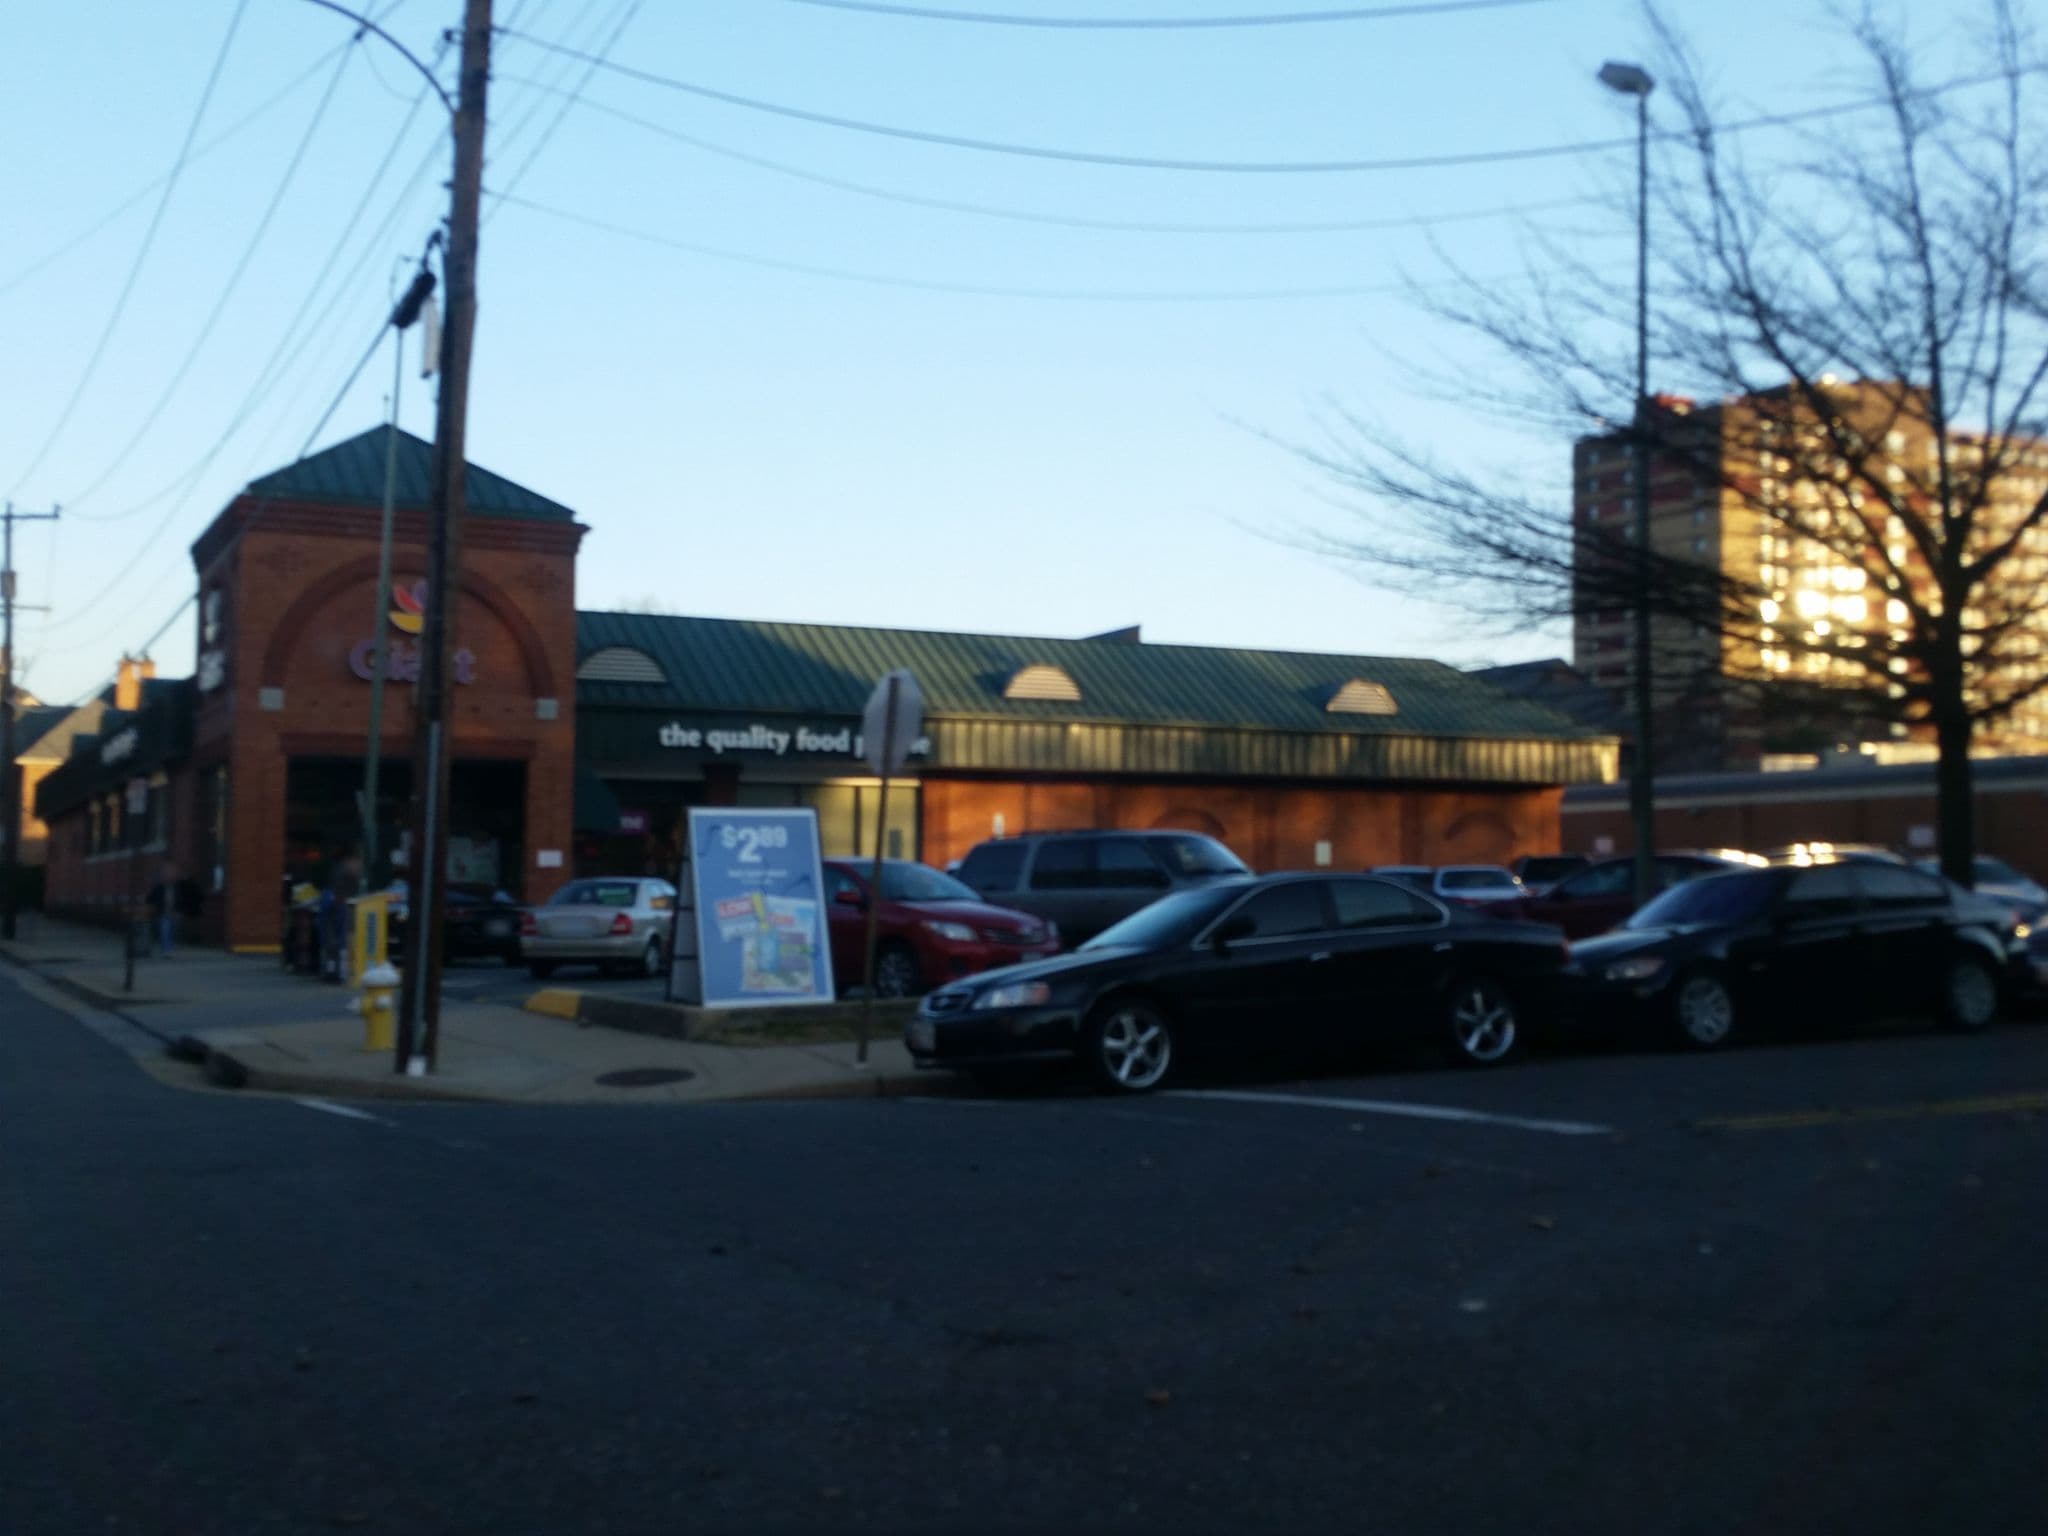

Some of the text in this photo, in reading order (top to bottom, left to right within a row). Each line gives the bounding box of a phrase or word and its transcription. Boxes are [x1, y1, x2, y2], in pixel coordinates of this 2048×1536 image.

[659, 723, 701, 747] the
[707, 726, 789, 755] quality
[797, 728, 848, 752] food
